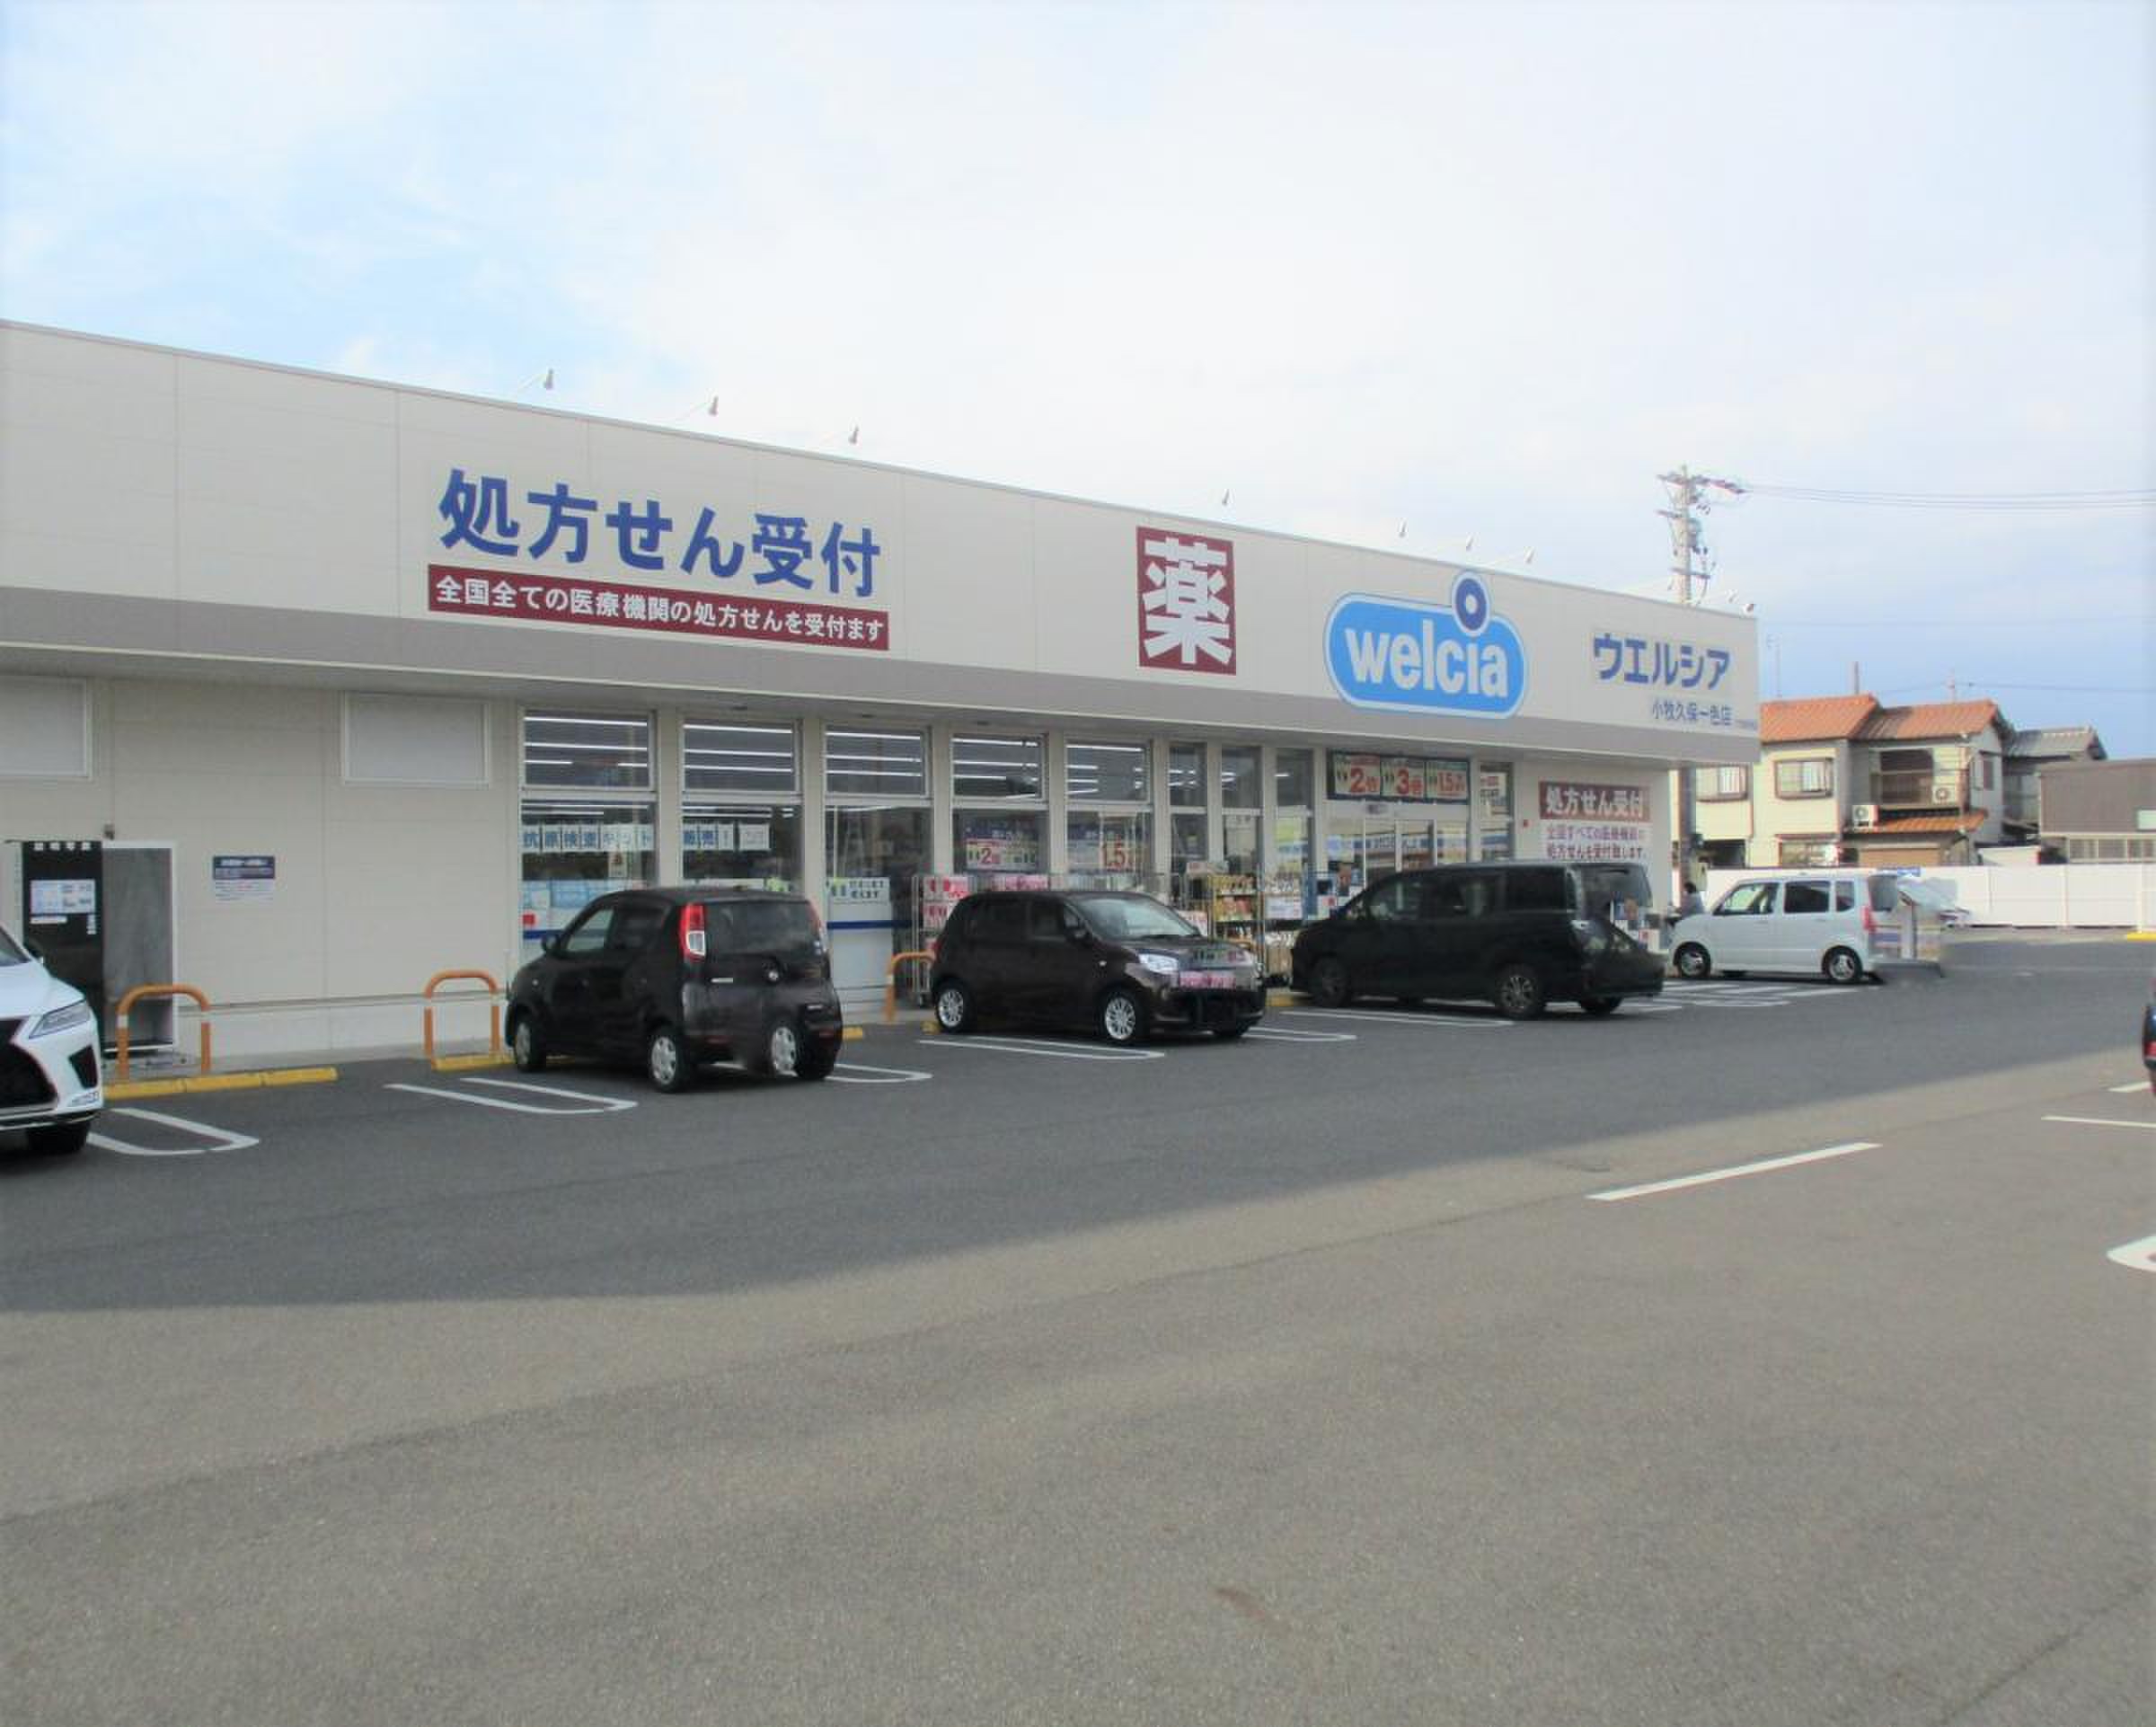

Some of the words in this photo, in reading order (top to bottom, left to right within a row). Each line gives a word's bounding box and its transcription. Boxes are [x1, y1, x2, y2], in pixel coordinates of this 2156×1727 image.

[438, 468, 880, 598] 処方せん受付
[436, 574, 884, 642] 全国全ての医療機関の処方せんを受付ます
[1144, 535, 1233, 666] 薬
[1344, 618, 1509, 698] welcia
[1594, 633, 1730, 690] ウエルシア
[1545, 785, 1643, 819] 処方せん受付
